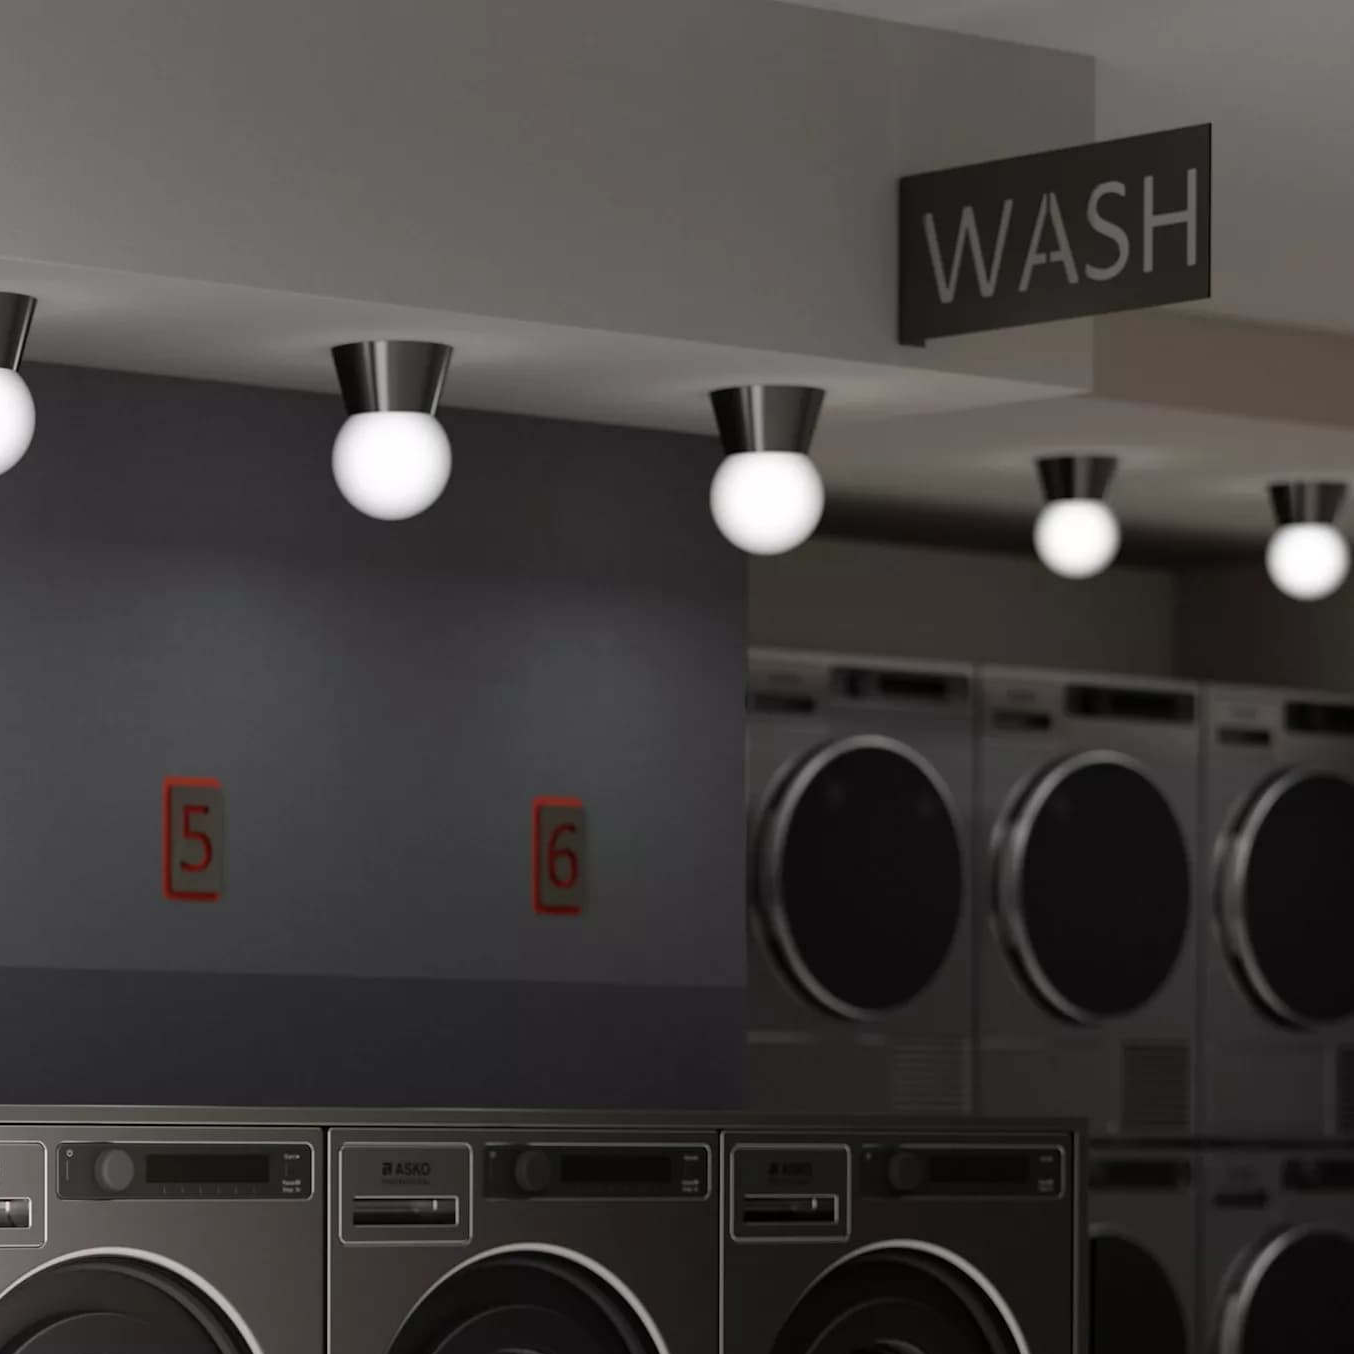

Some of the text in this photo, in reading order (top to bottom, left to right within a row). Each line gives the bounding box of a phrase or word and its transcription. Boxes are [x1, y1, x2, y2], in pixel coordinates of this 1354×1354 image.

[923, 168, 1197, 304] WASH
[180, 804, 213, 873] 5
[548, 823, 579, 889] 6
